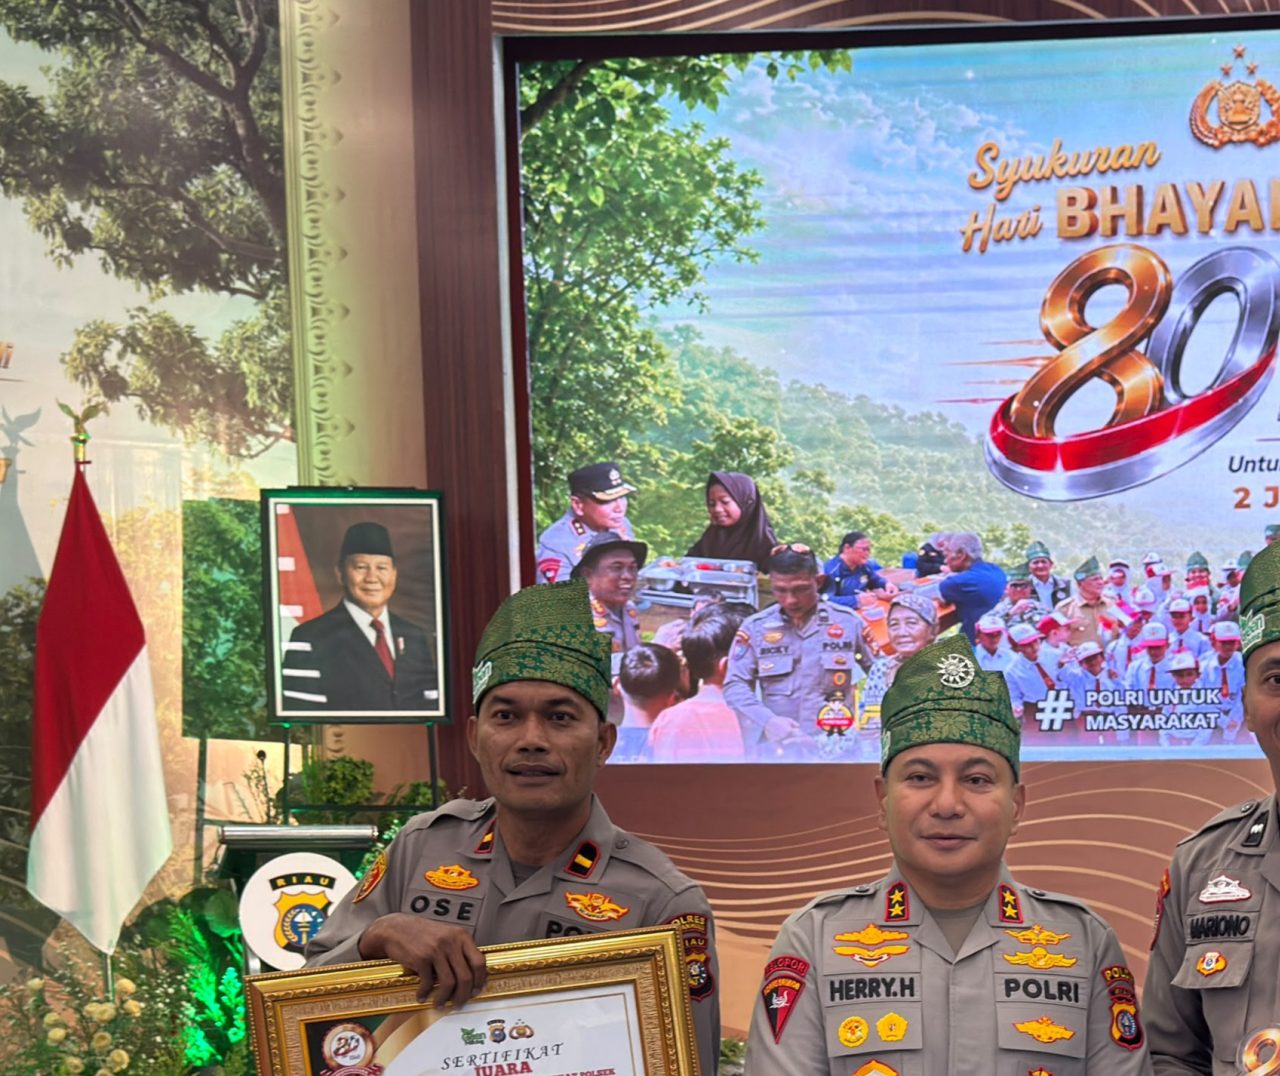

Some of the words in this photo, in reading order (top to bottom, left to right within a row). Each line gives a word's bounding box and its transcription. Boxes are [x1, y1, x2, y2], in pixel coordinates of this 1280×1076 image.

[966, 138, 1162, 201] Syukuran
[959, 200, 1044, 255] Hari
[1233, 485, 1251, 510] 2
[1086, 690, 1144, 707] POLRI
[1149, 688, 1221, 705] UNTUK
[1085, 712, 1220, 731] MASYARAKAT
[275, 876, 330, 888] RIAU
[410, 895, 475, 922] OSE
[829, 977, 915, 1002] HERRY.H
[1004, 978, 1079, 1003] POLRI
[441, 1042, 564, 1071] SERTIFIKAT
